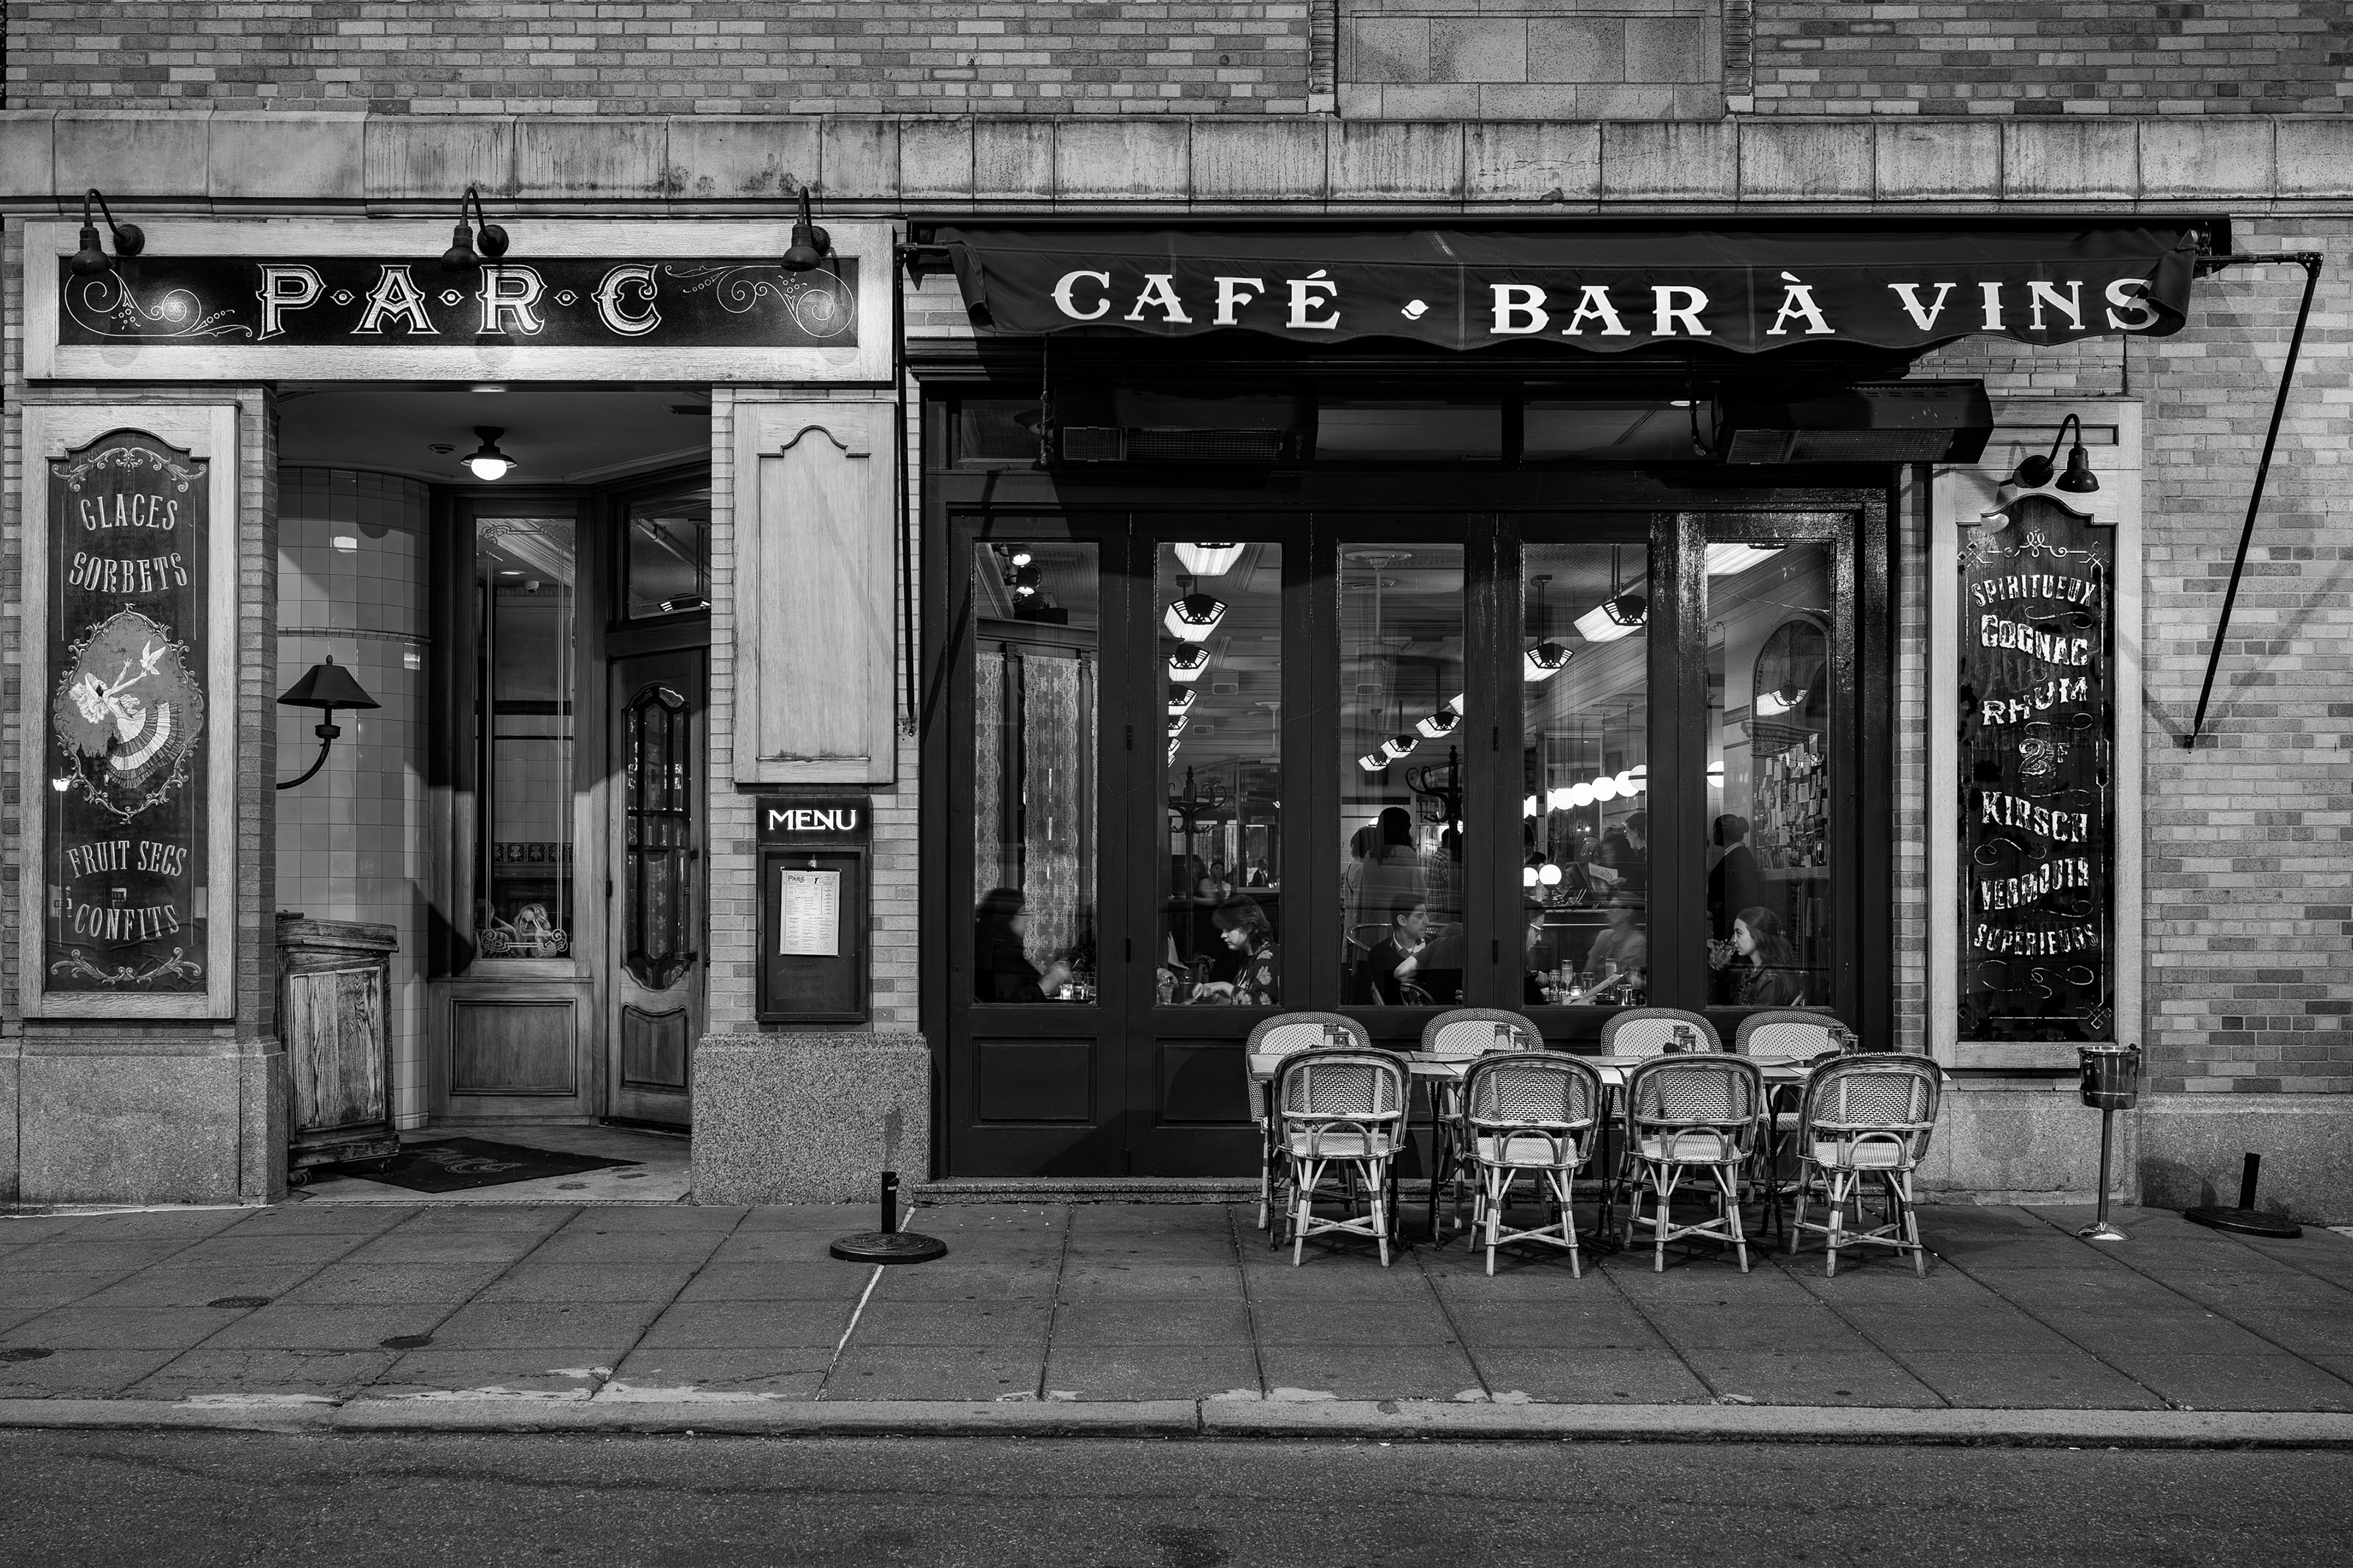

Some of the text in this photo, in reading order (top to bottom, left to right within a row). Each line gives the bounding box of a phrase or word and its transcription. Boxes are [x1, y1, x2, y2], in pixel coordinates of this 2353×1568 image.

[1051, 269, 2160, 336] CAFÉ BAR À VINS
[80, 493, 179, 531] GLACES
[68, 552, 188, 593] SORBETS
[1971, 574, 2096, 607] SPIRITUEUX
[1981, 615, 2088, 666] COGNAC
[1982, 677, 2088, 726] RHUM
[768, 809, 857, 831] MENU
[1981, 791, 2088, 842] KIRSCH
[65, 840, 187, 879] FRUIT SECS
[1980, 857, 2089, 910] VERMOUTH
[74, 904, 179, 941] CONFITS
[1974, 923, 2099, 955] SUPÉRIEURS
